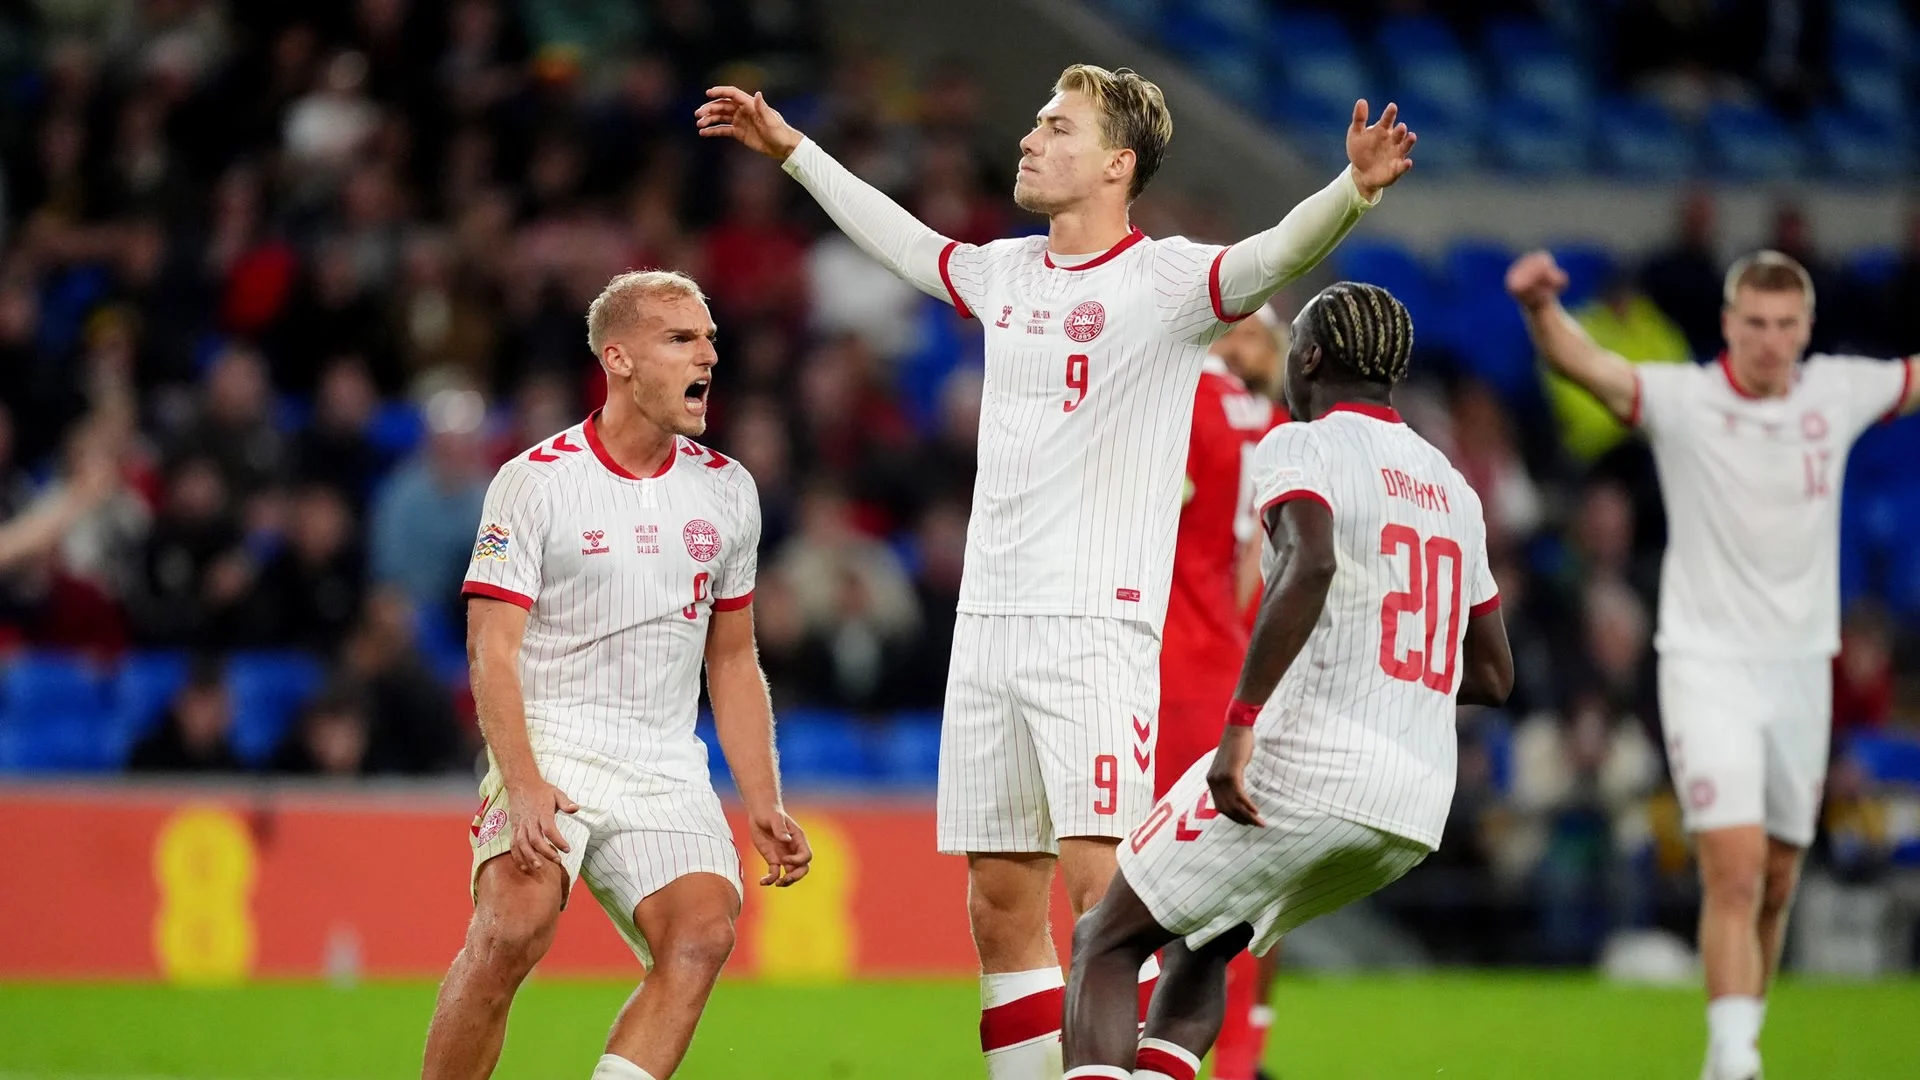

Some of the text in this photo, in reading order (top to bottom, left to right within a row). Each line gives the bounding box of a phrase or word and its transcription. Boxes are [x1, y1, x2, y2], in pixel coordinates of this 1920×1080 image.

[1073, 314, 1096, 326] DBU
[1063, 354, 1089, 412] 9
[1381, 468, 1450, 514] DARAMY
[634, 524, 659, 534] WAL-DEN
[692, 533, 714, 545] DBU
[581, 546, 610, 556] hummel
[637, 545, 660, 555] 04.10.26
[1379, 522, 1463, 696] 20
[1094, 754, 1118, 816] 9
